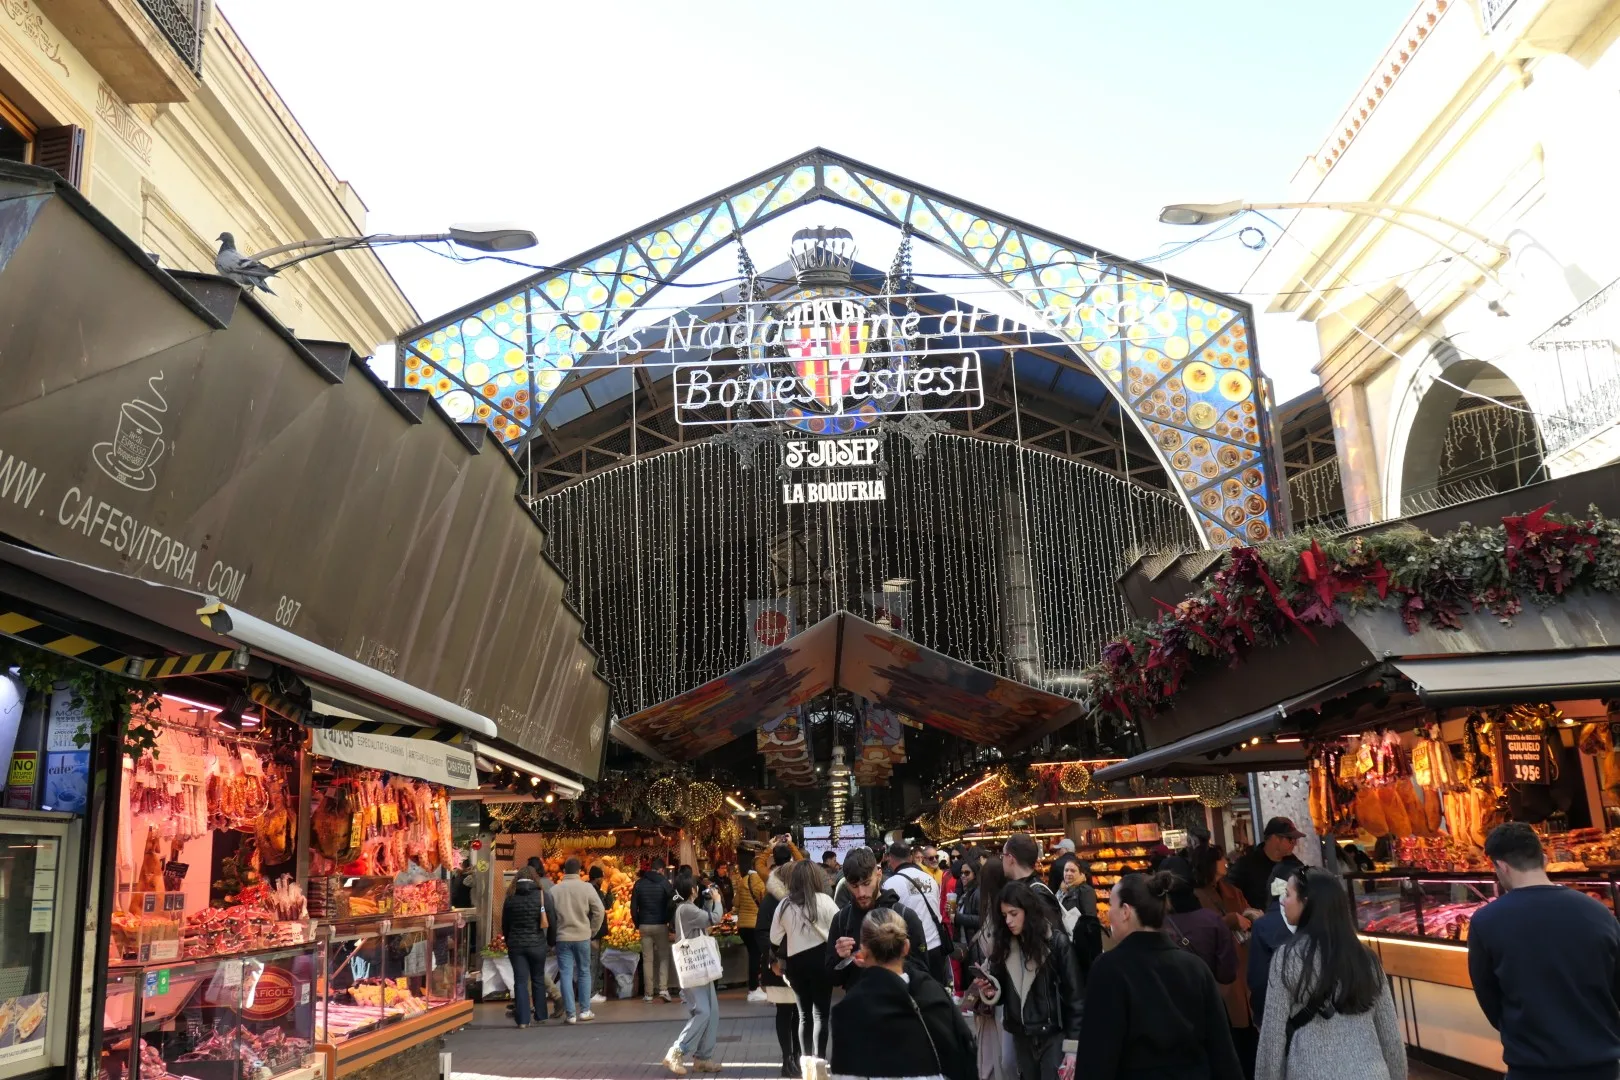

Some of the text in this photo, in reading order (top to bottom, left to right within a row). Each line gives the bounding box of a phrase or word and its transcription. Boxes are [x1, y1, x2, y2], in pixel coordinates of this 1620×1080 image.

[939, 306, 980, 337] al
[681, 363, 820, 410] Bones
[120, 435, 147, 456] ESPRESSO
[807, 438, 880, 467] JOSEP
[782, 480, 887, 504] LA BOQUERIA
[275, 595, 302, 628] 887
[1508, 741, 1541, 752] GUIJUELO
[13, 761, 33, 771] NO
[1514, 764, 1541, 782] 195€
